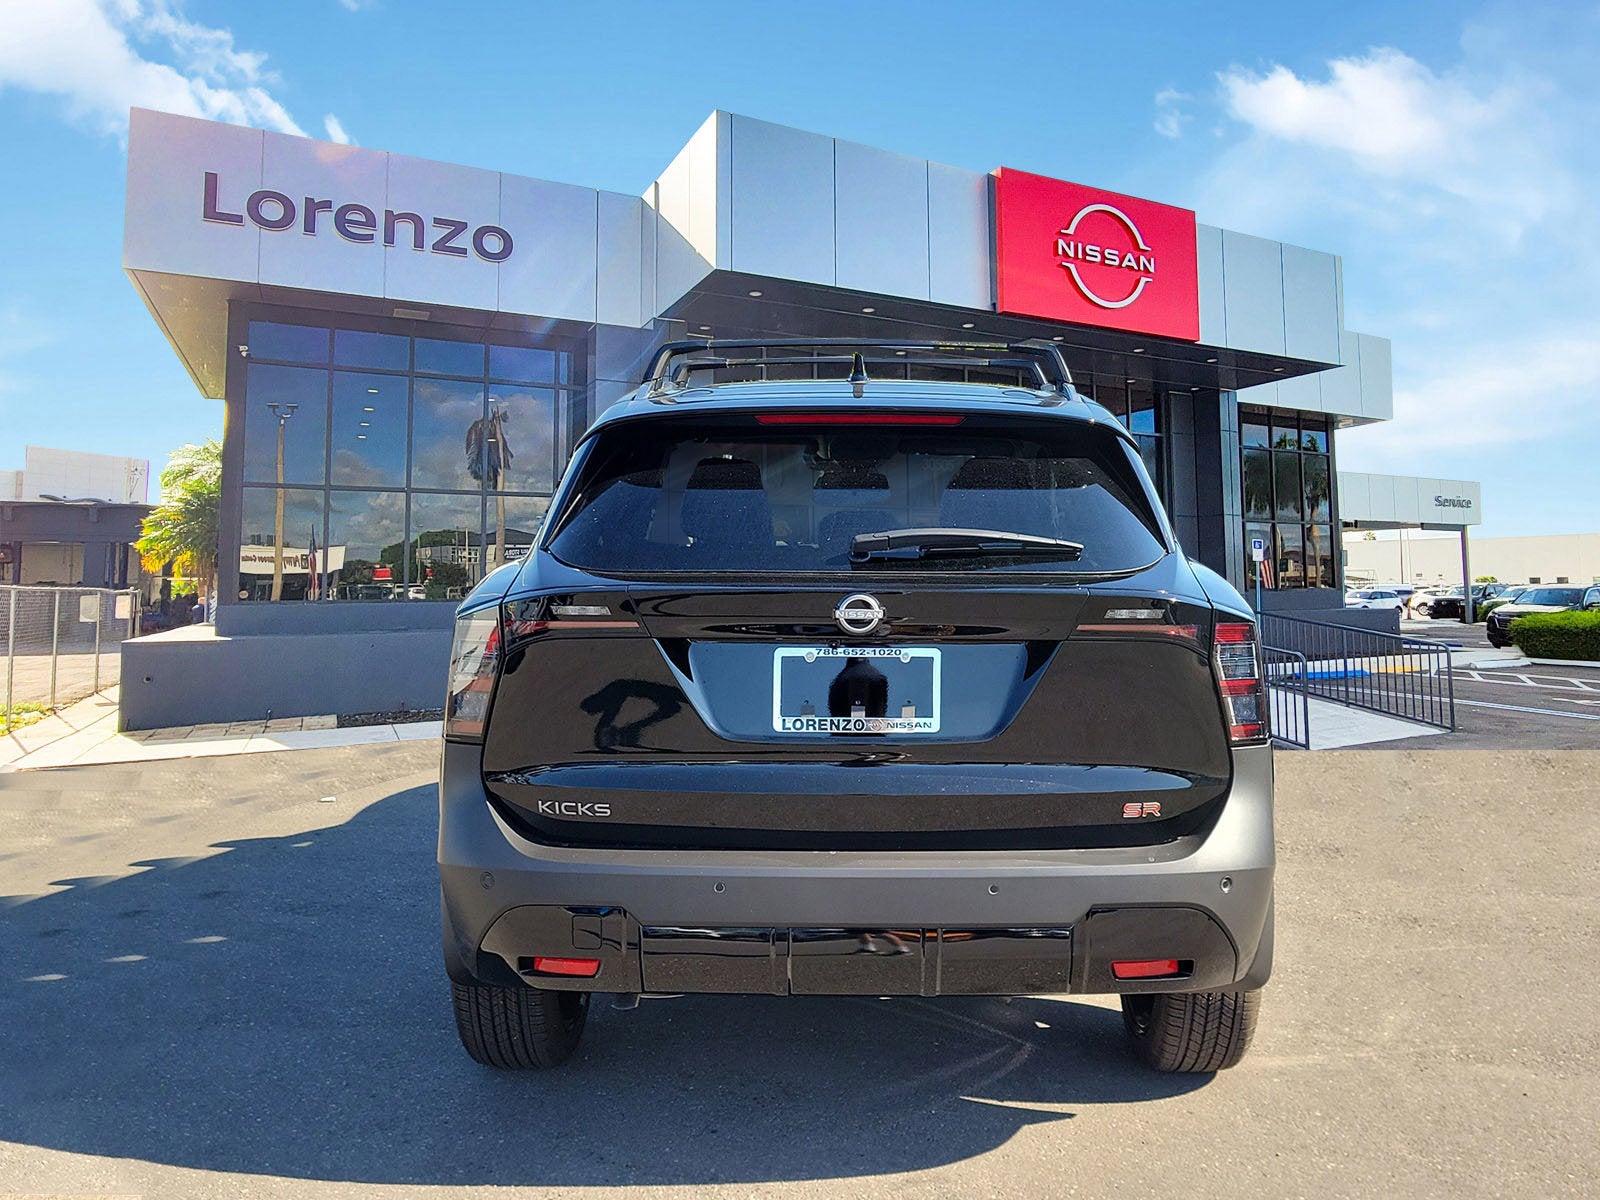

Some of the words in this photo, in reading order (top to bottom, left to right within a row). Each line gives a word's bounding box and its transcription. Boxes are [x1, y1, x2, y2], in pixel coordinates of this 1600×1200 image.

[202, 171, 514, 262] Lorenzo
[1057, 238, 1155, 273] NISSAN
[1434, 495, 1472, 508] Service
[835, 610, 883, 619] NISSAN
[815, 648, 902, 656] 786-652-1020
[781, 718, 865, 731] LORENZO
[886, 721, 932, 729] NISSAN
[538, 800, 611, 817] KICKS
[1123, 802, 1161, 818] SR
